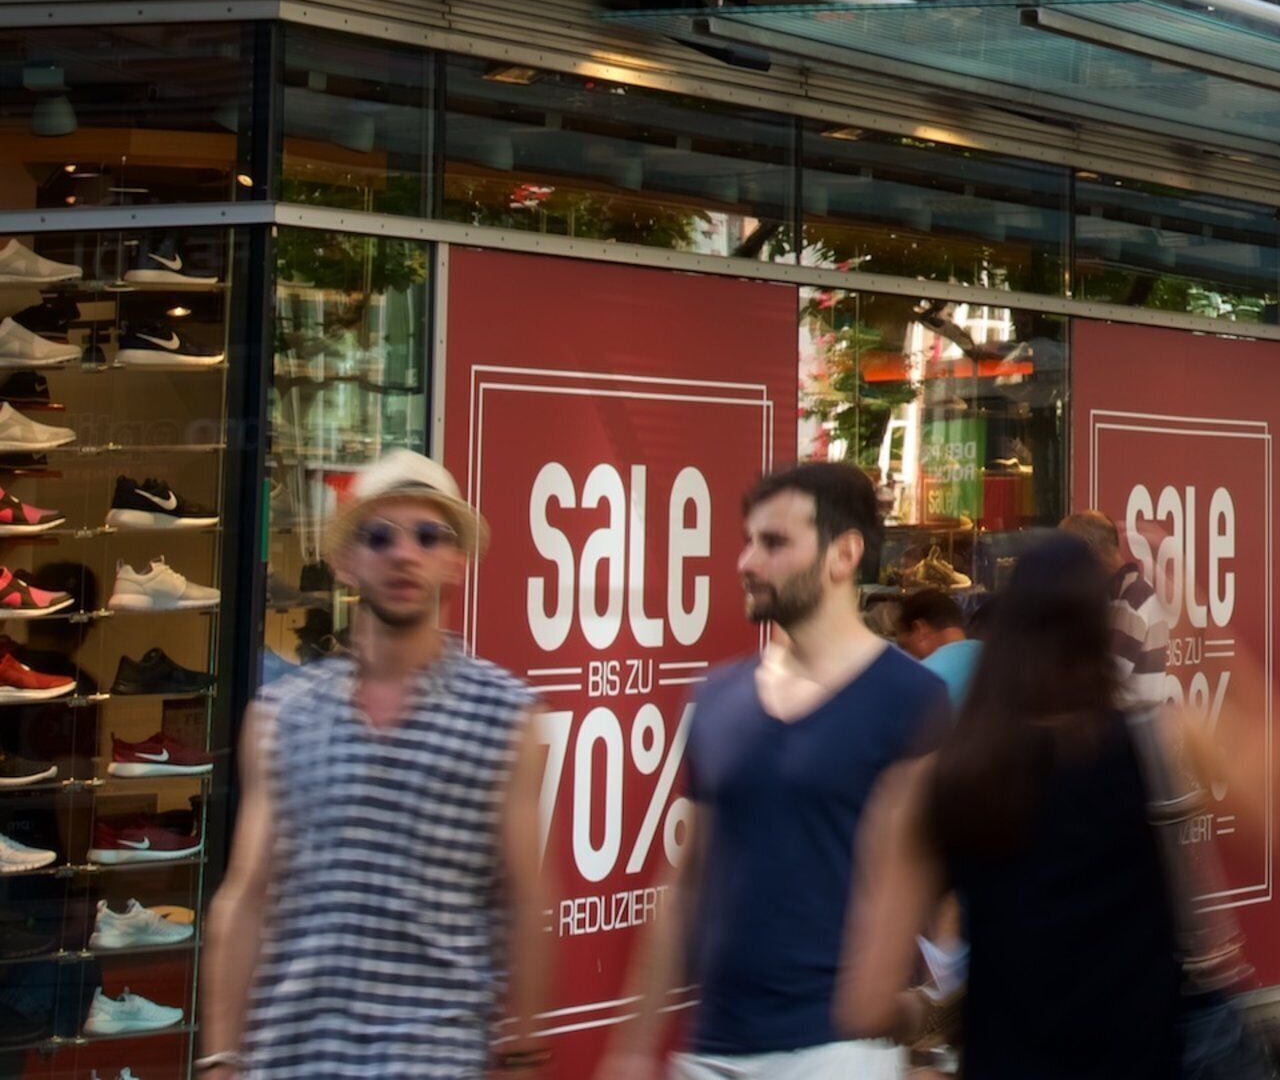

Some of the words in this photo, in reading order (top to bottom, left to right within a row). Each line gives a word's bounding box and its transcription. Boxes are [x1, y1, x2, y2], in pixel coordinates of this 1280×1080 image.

[527, 461, 711, 652] sale
[588, 660, 620, 697] BIS
[625, 659, 653, 695] ZU
[1184, 637, 1202, 665] ZU
[532, 702, 698, 883] 70%
